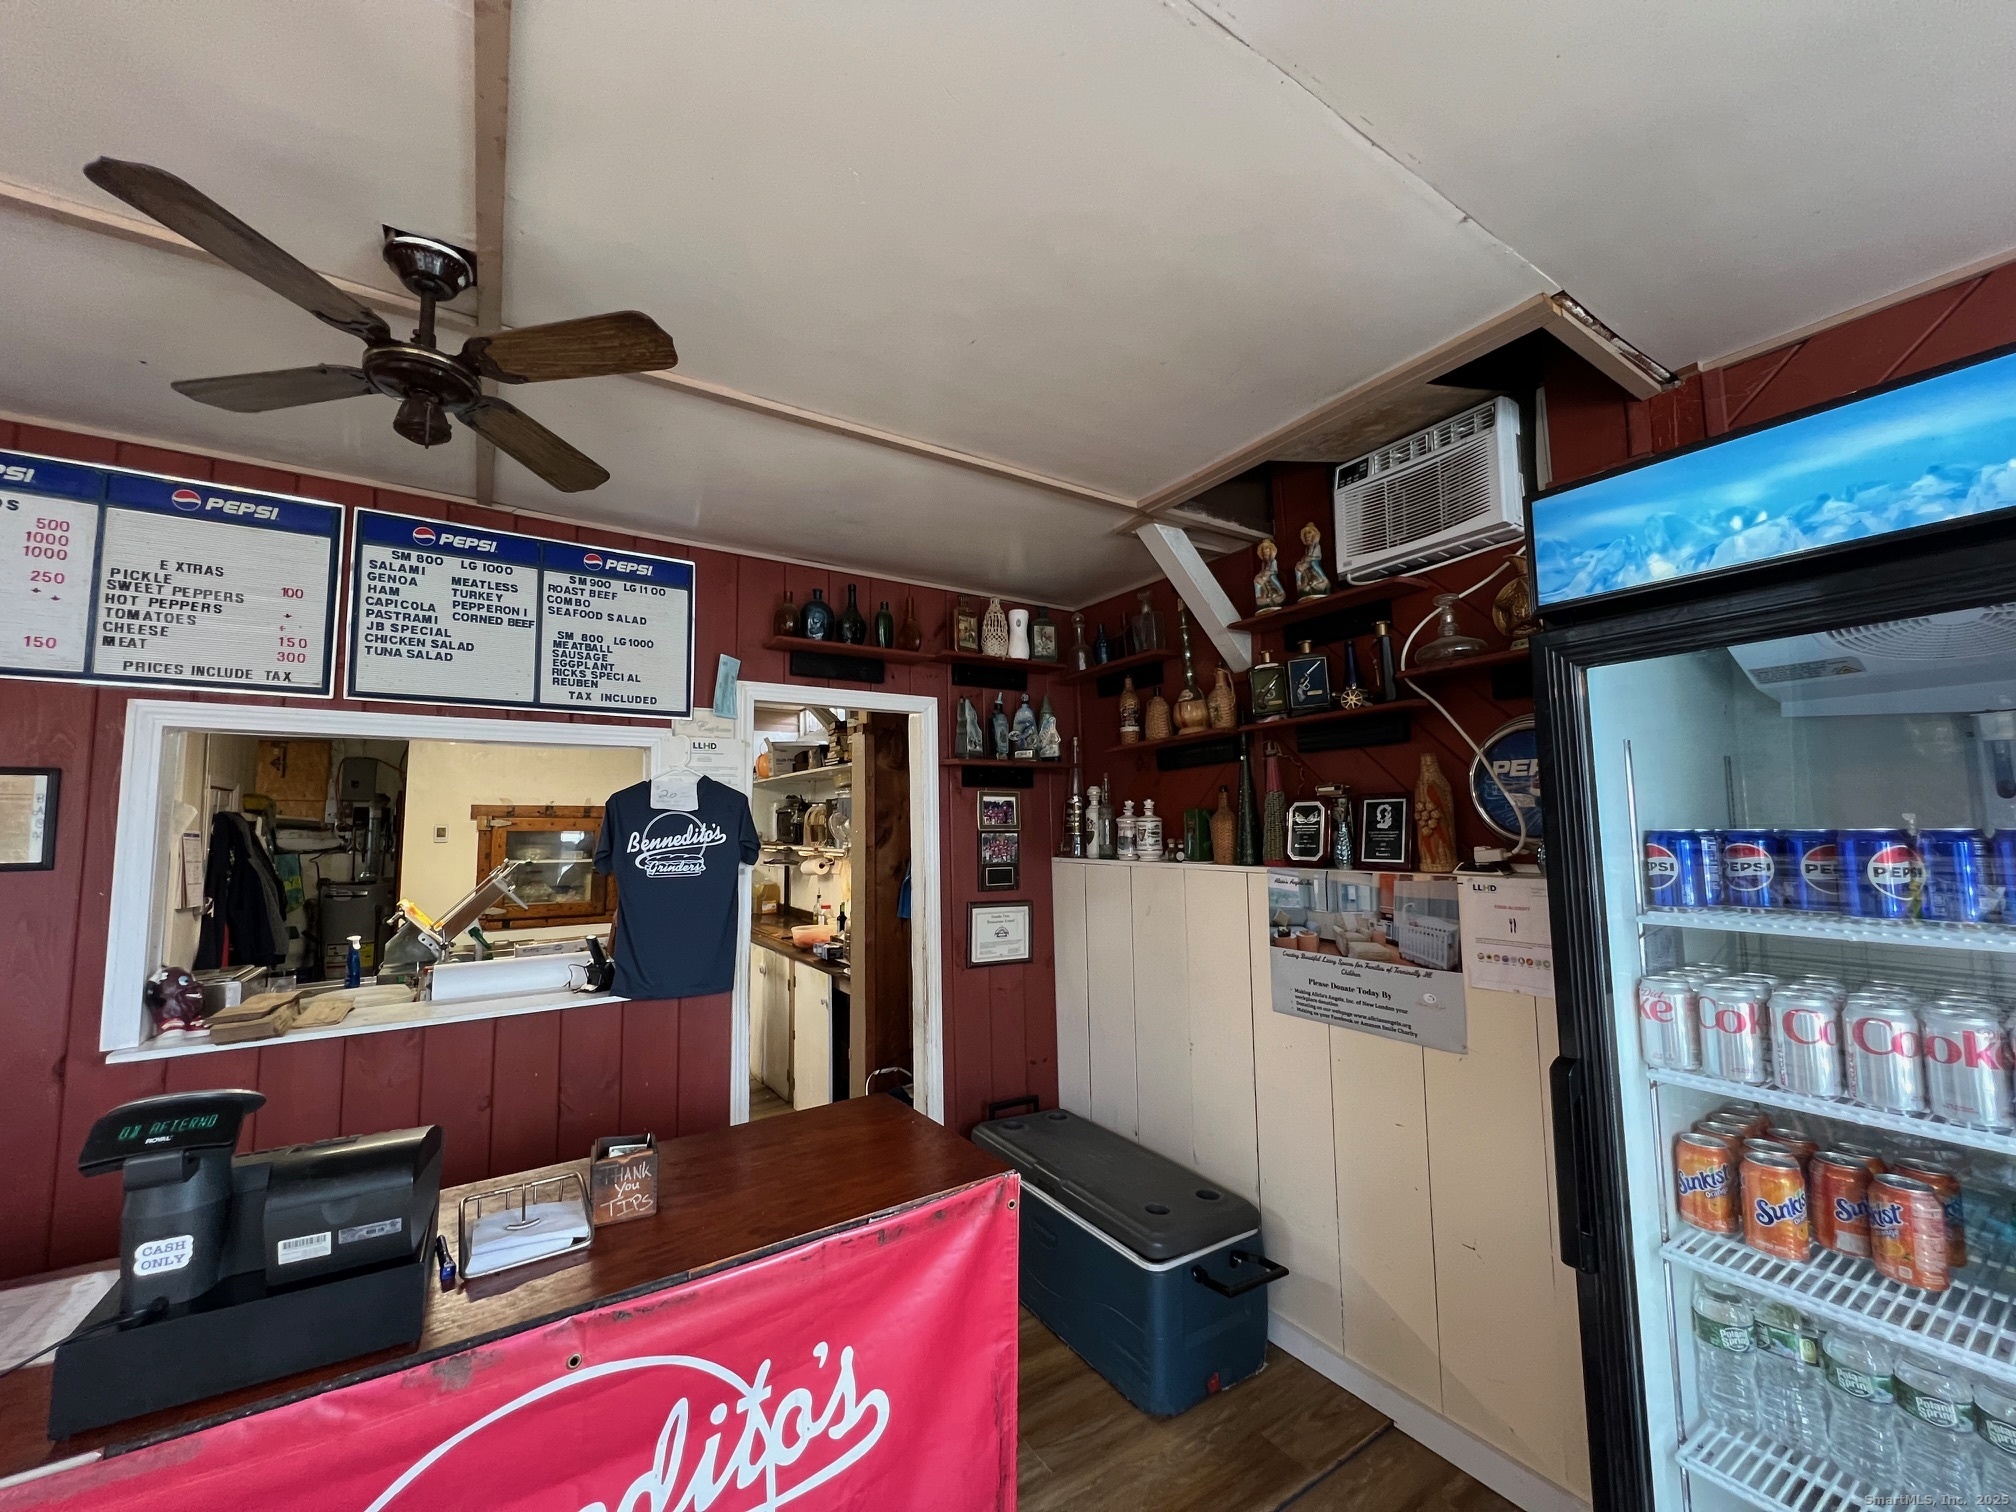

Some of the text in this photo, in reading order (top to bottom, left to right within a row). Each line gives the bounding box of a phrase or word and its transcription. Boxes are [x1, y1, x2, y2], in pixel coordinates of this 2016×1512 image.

[205, 497, 280, 520] PEPSI
[36, 517, 70, 532] 500
[25, 531, 69, 547] 1000
[439, 533, 497, 553] PEPSI
[23, 545, 68, 560] 1000
[369, 560, 426, 576] SALAMI
[391, 550, 513, 575] SM 800 LG 1000
[605, 559, 653, 577] PEPSI
[30, 570, 65, 584] 250
[110, 568, 172, 585] PICKLE
[367, 572, 418, 587] GENOA
[569, 576, 587, 586] SM
[589, 578, 612, 589] 900
[623, 583, 637, 593] LG
[106, 580, 244, 604] SWEET PEPPERS
[281, 587, 304, 599] 100
[367, 584, 400, 597] HAM
[451, 577, 519, 593] MEATLESS
[547, 584, 618, 601] ROAST BEEF
[105, 593, 223, 614] HOT PEPPERS
[451, 589, 503, 603] TURKEY
[546, 595, 591, 608] COMBO
[365, 596, 436, 613] CAPICOLA
[452, 600, 527, 617] PEPPERONI
[104, 607, 197, 626] TOMATOES
[365, 609, 438, 625] PASTRAMI
[452, 612, 535, 629] CORNED BEEF
[547, 606, 647, 626] SEAFOOD SALAD
[103, 621, 169, 637] CHEESE
[366, 620, 452, 638] JB SPECIAL
[24, 636, 57, 649] 150
[102, 635, 148, 649] MEAT
[278, 636, 308, 649] 150
[364, 633, 475, 652] CHICKEN SALAD
[552, 640, 613, 654] MEATBALL
[557, 630, 654, 649] SM 800 LG 1000
[277, 651, 306, 664] 300
[364, 646, 453, 662] TUNA SALAD
[552, 649, 608, 663] SAUSAGE
[123, 661, 292, 683] PRICES INCLUDE TAX
[552, 659, 615, 672] EGGPLANT
[551, 668, 641, 683] RICKS SPECIAL
[552, 677, 598, 689] REUBEN
[568, 691, 658, 705] TAX INCLUDED
[692, 742, 717, 750] LLHD
[1804, 864, 1837, 875] PE
[1873, 866, 1923, 878] PEPSI
[1473, 884, 1497, 892] LLHD
[1322, 956, 1337, 965] Living
[1354, 961, 1364, 969] for
[1386, 964, 1393, 974] of
[1308, 978, 1392, 1001] Please Donate Today By
[1294, 988, 1311, 997] Making
[1362, 1001, 1375, 1009] New
[1375, 1002, 1395, 1012] London
[1395, 1006, 1408, 1014] your
[1296, 1006, 1313, 1016] Making
[1382, 1024, 1397, 1033] Smile
[1398, 1027, 1418, 1038] Charity
[145, 1135, 172, 1144] ROYAL
[1678, 1163, 1730, 1195] Sunkist
[600, 1194, 654, 1217] TIPS
[142, 1241, 186, 1257] CASH
[141, 1254, 186, 1270] ONLY
[578, 1341, 890, 1512] dito's
